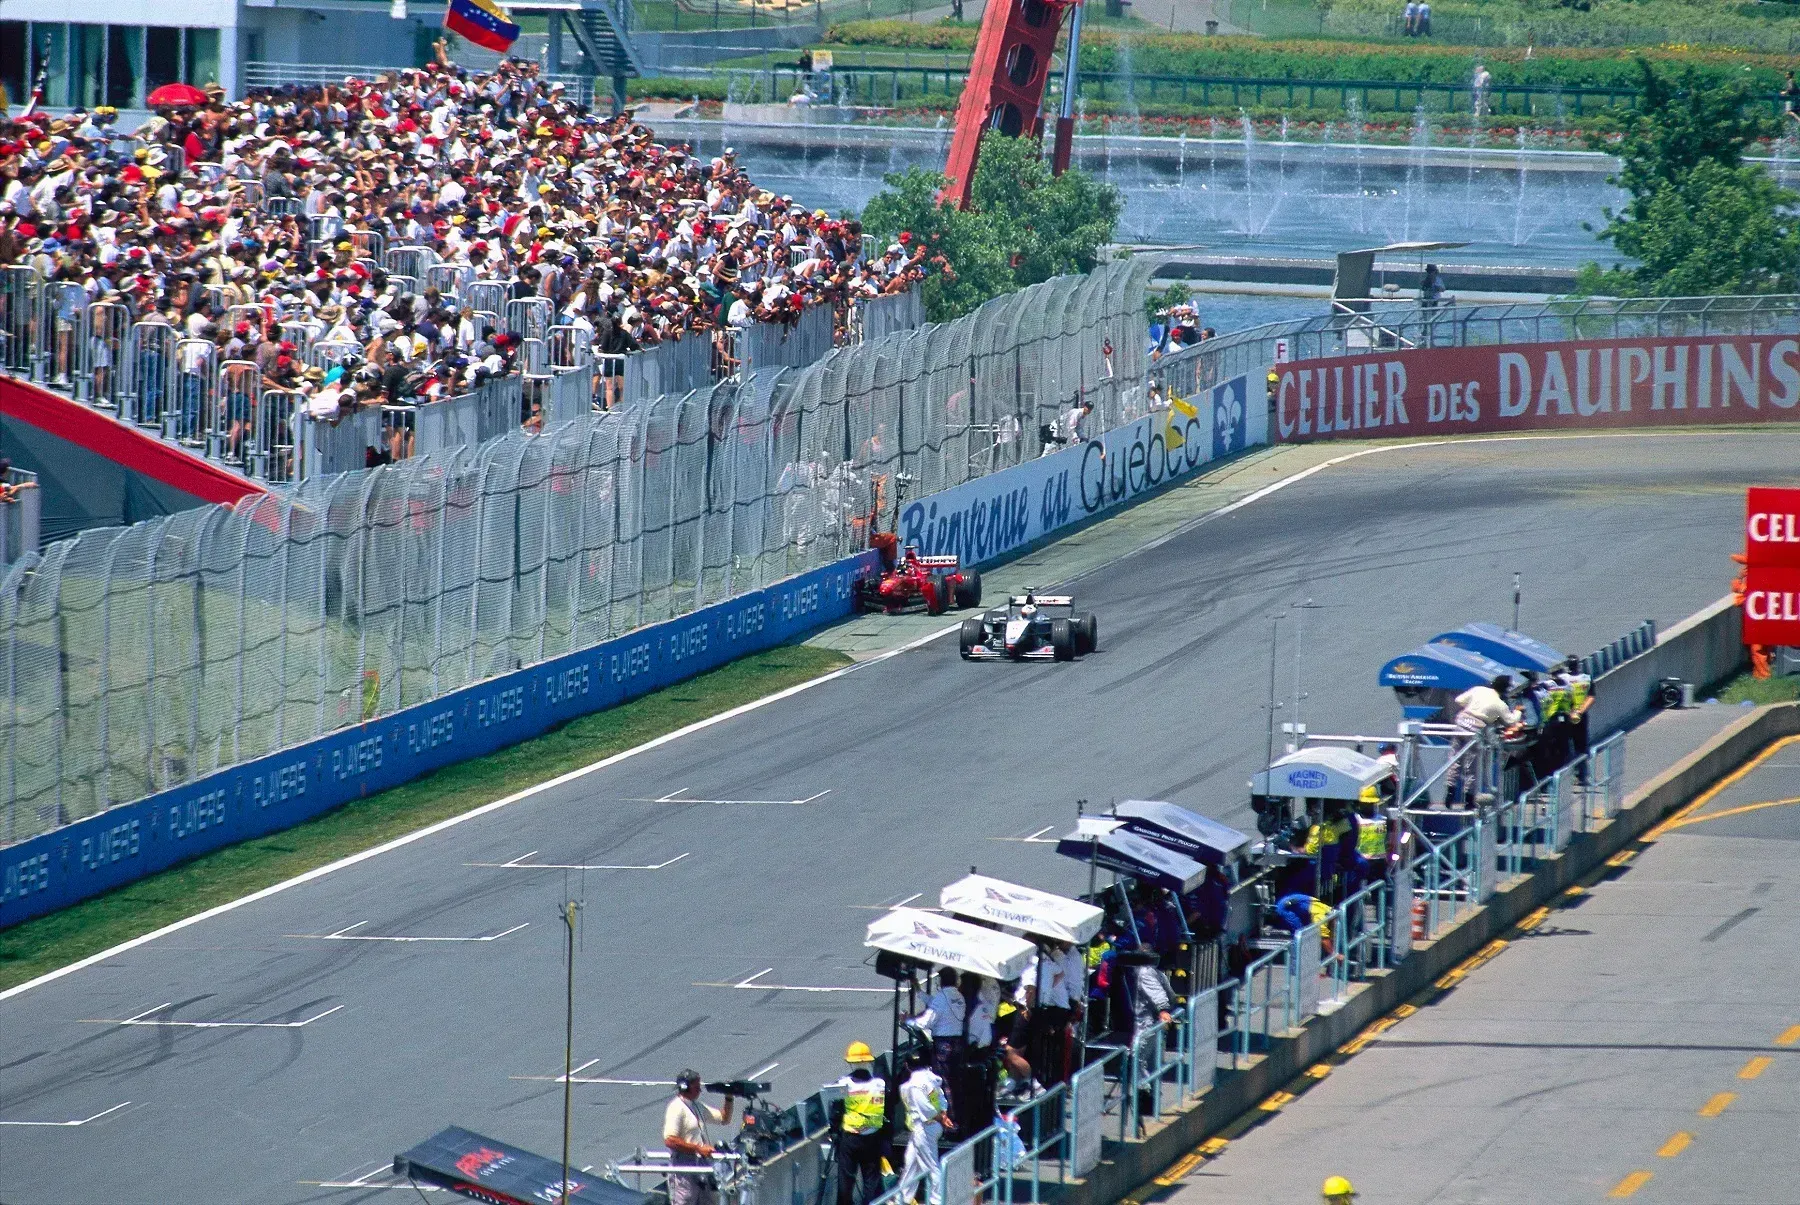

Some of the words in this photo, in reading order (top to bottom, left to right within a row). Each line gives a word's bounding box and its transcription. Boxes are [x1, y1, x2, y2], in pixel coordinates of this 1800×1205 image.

[1277, 343, 1286, 359] F
[1278, 360, 1410, 439] CELLIER
[1428, 380, 1481, 423] DES
[1498, 339, 1800, 417] DAUPHINS
[902, 485, 1029, 570] Bienvenue
[1040, 469, 1071, 531] au
[1079, 417, 1201, 513] Québec
[1745, 591, 1800, 620] CEL
[982, 904, 1036, 926] STEWART
[909, 941, 964, 962] STEWART
